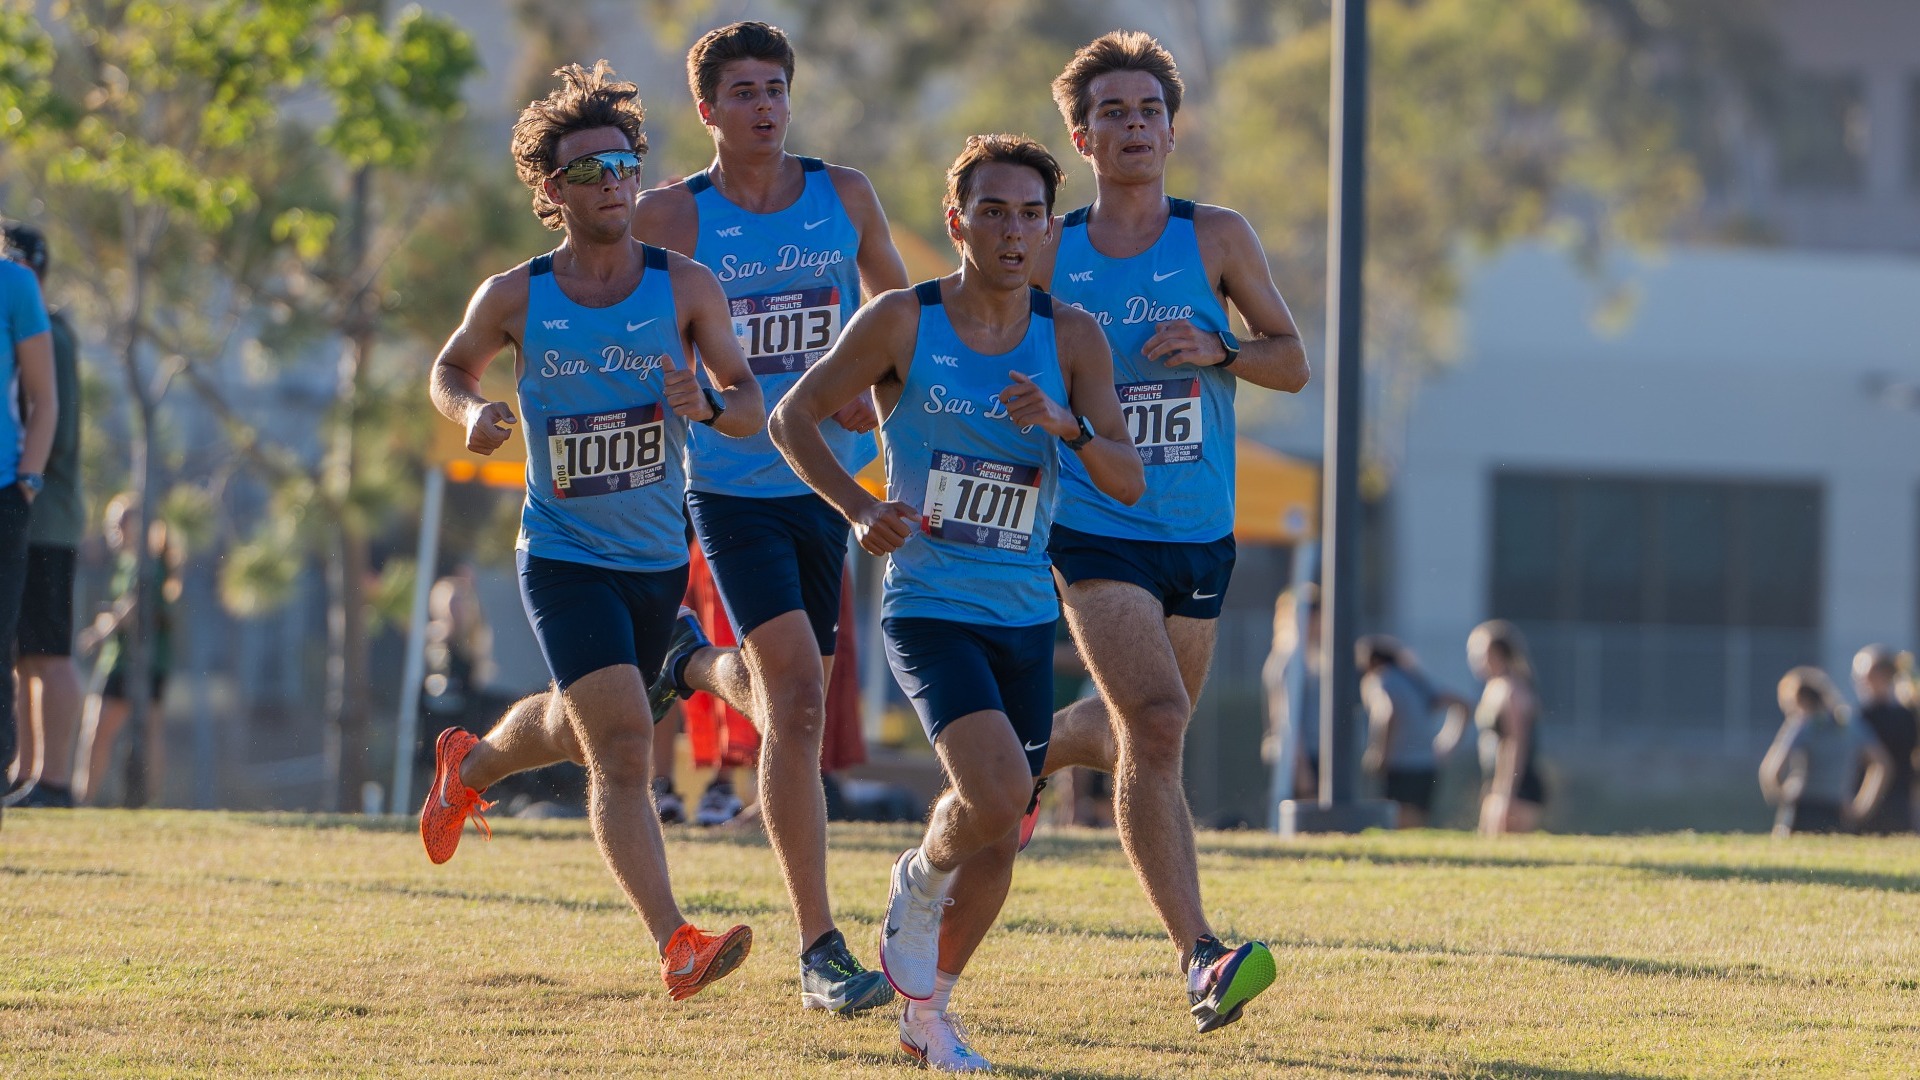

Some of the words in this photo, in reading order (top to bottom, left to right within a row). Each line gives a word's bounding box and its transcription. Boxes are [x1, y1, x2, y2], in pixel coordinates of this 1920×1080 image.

[716, 225, 743, 238] WCC
[718, 254, 767, 282] San
[775, 244, 844, 278] Diego
[1069, 270, 1094, 283] WCC
[770, 293, 803, 303] FINISHED
[770, 302, 802, 312] RESULTS
[542, 319, 570, 330] WCC
[746, 309, 832, 356] 1013
[540, 349, 590, 378] San
[598, 345, 663, 380] Diego
[931, 354, 959, 368] WCC
[1129, 384, 1163, 394] FINISHED
[923, 384, 976, 415] San
[1128, 392, 1162, 402] RESULTS
[593, 412, 627, 424] FINISHED
[1122, 401, 1192, 445] 016
[593, 420, 626, 432] RESULTS
[564, 425, 662, 477] 1008
[981, 461, 1014, 473] FINISHED
[556, 464, 568, 487] 1008
[979, 470, 1011, 482] RESULTS
[953, 479, 1028, 529] 1011
[931, 502, 943, 526] 1011
